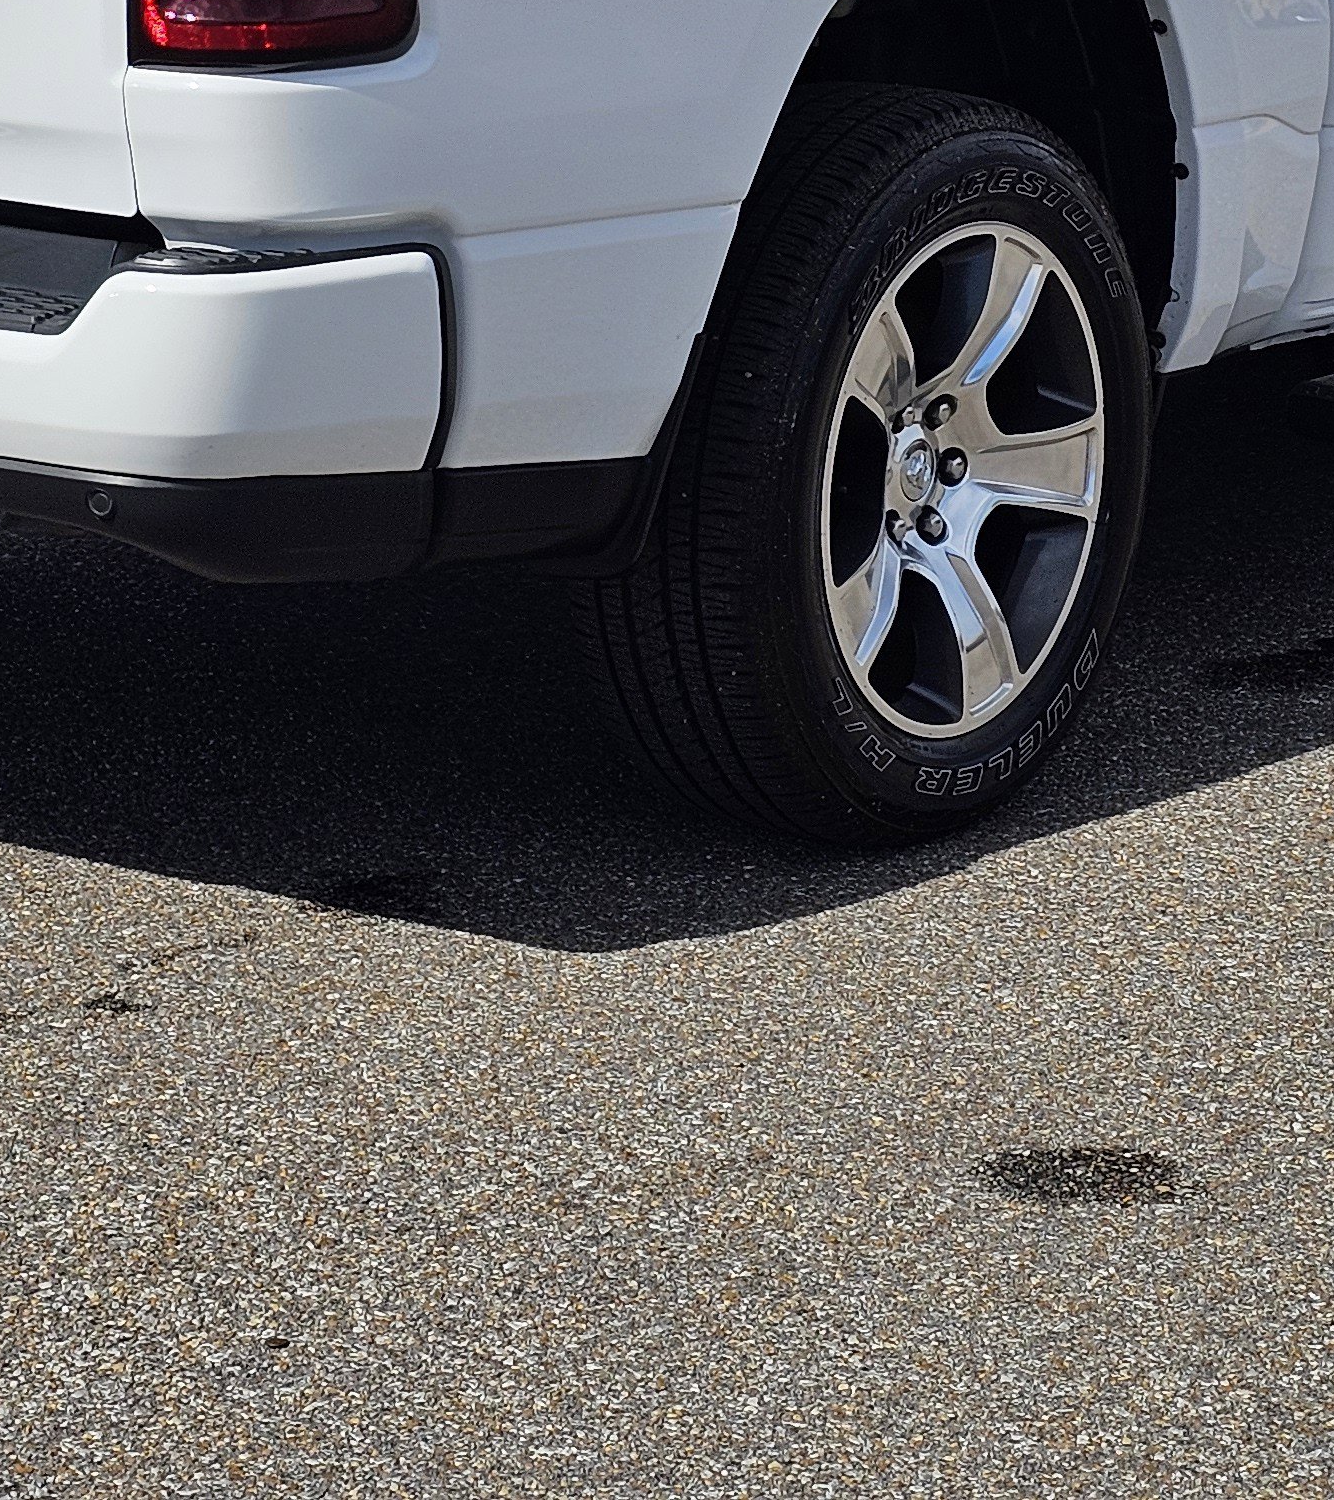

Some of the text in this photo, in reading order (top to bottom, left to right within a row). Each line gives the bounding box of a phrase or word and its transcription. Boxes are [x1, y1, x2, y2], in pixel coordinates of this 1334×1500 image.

[849, 165, 1130, 335] BRIDGESTONE
[832, 627, 1100, 796] DUELER H/L
